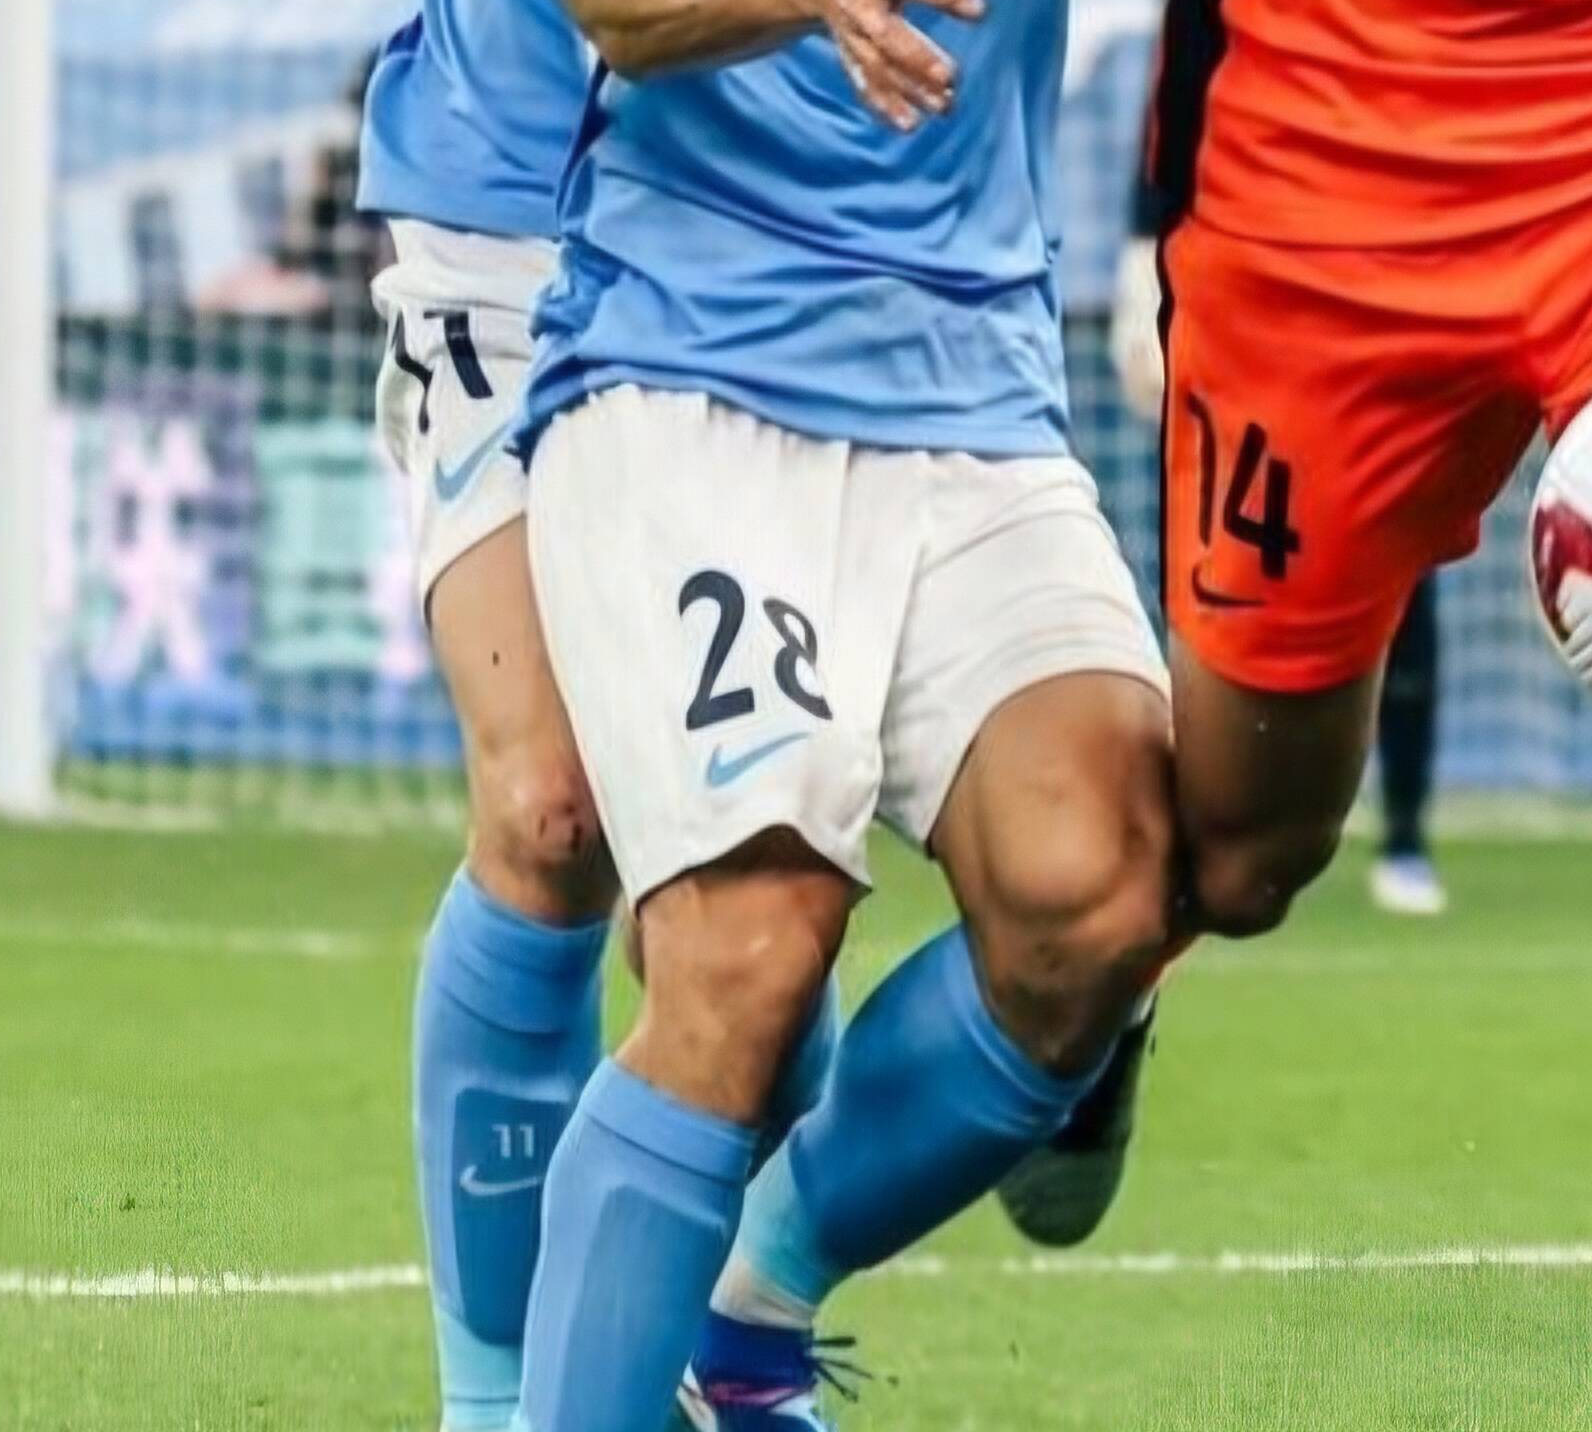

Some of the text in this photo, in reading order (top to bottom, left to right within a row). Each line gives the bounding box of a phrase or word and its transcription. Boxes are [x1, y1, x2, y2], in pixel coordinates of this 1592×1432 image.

[1186, 390, 1301, 581] 14
[678, 569, 834, 731] 28
[491, 1123, 535, 1159] 11
